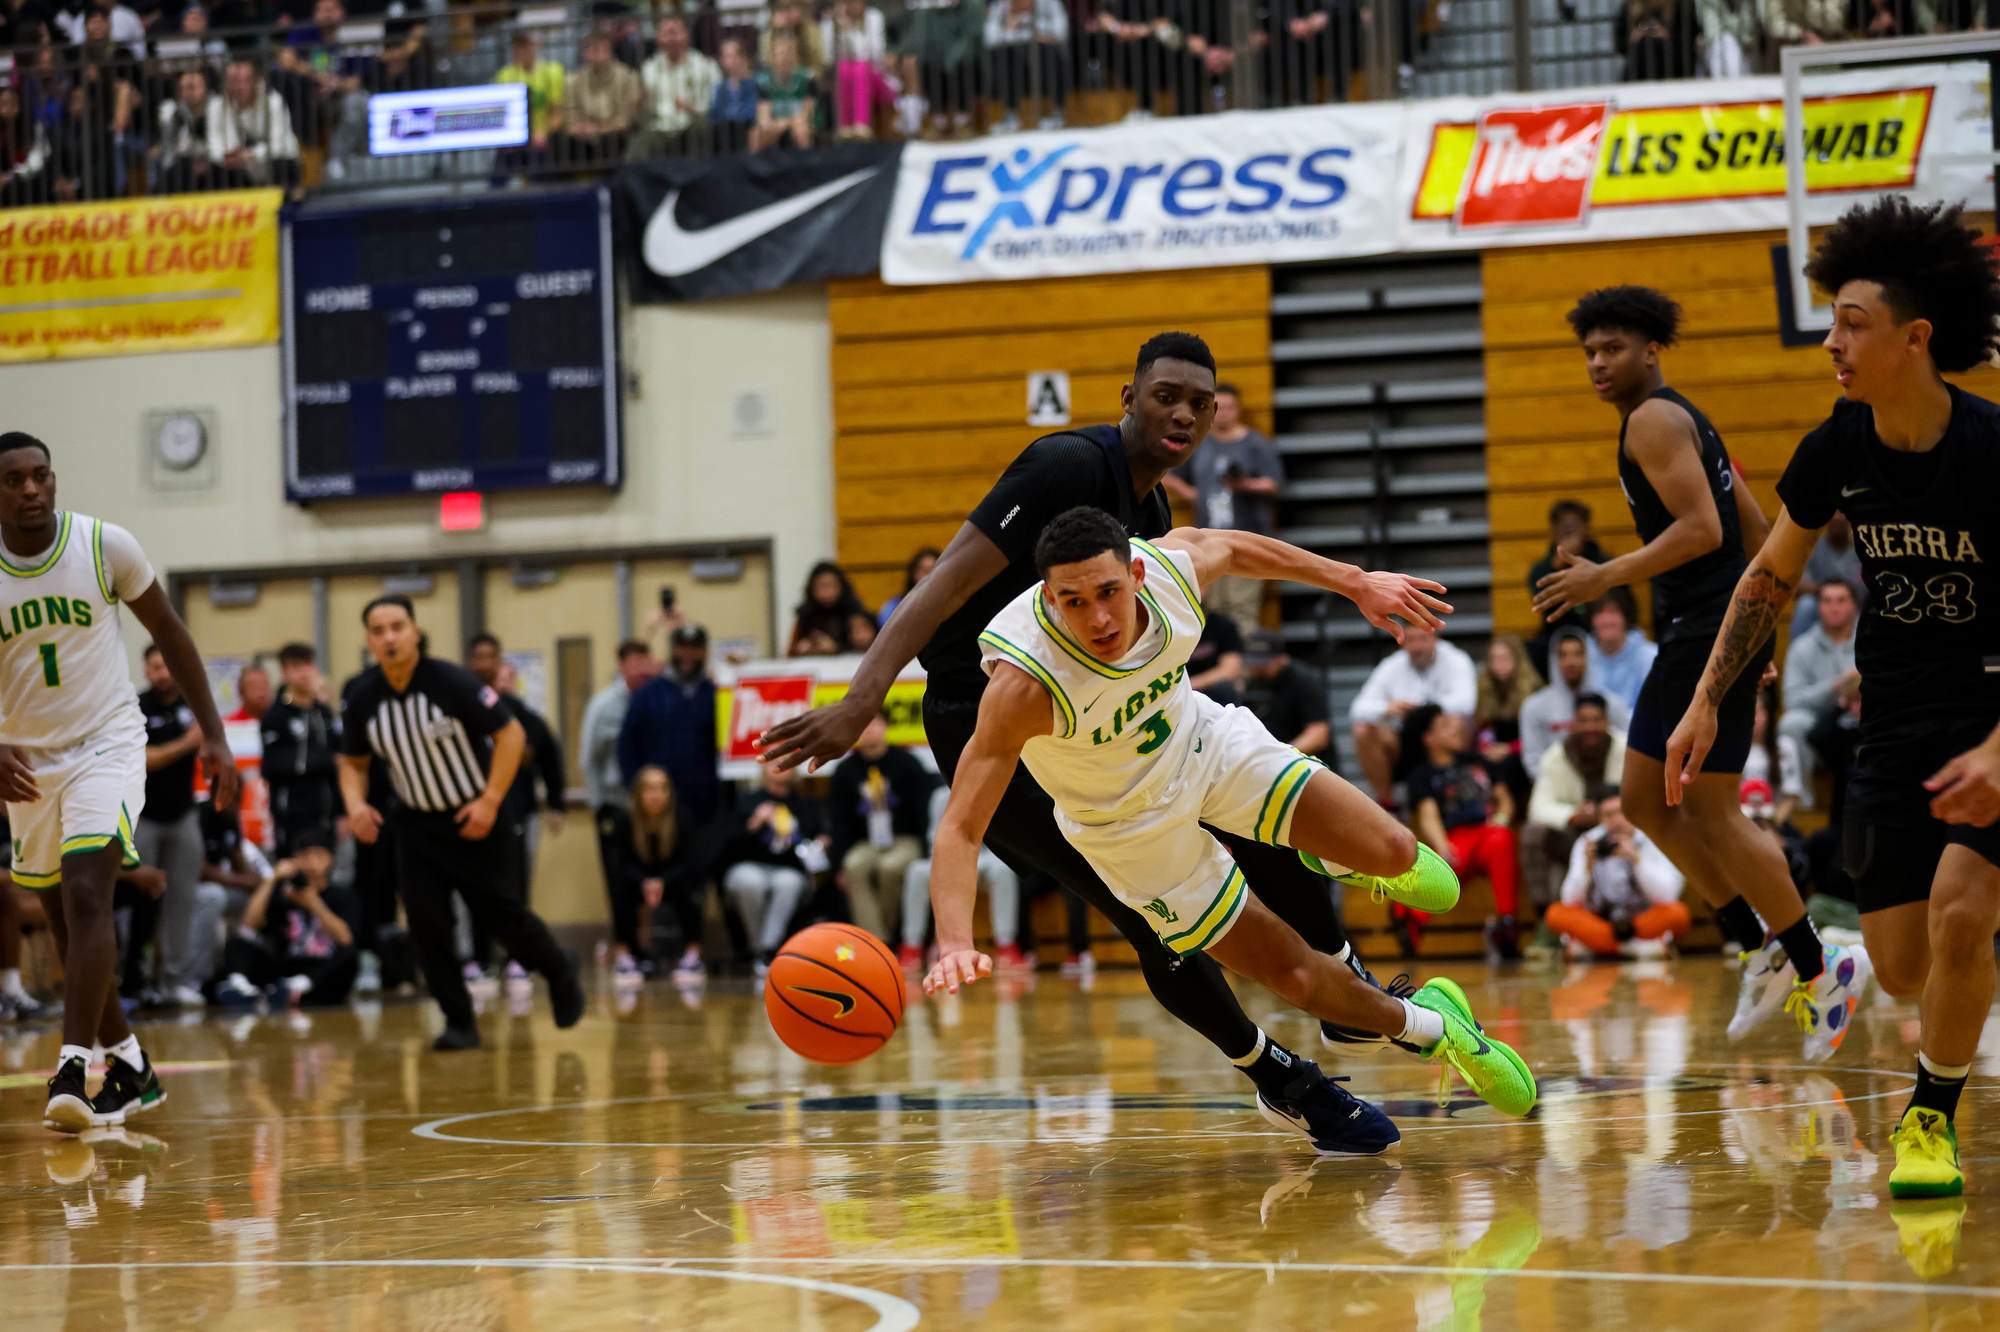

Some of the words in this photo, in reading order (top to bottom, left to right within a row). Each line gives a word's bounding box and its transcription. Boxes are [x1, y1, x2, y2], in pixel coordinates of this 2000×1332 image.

[1476, 118, 1596, 198] Tires
[1606, 132, 1682, 178] LES
[1695, 118, 1905, 173] SCHWAB
[22, 212, 136, 248] GRADE
[146, 202, 259, 239] YOUTH
[0, 249, 117, 288] ETBALL
[127, 236, 255, 277] LEAGUE
[515, 267, 596, 299] GUEST
[304, 283, 373, 313] HOME
[1031, 376, 1066, 416] A
[1856, 522, 1984, 563] SIERRA
[0, 595, 92, 643] LIONS
[1875, 570, 1978, 624] 23
[38, 641, 62, 688] 1
[1134, 707, 1174, 756] 3
